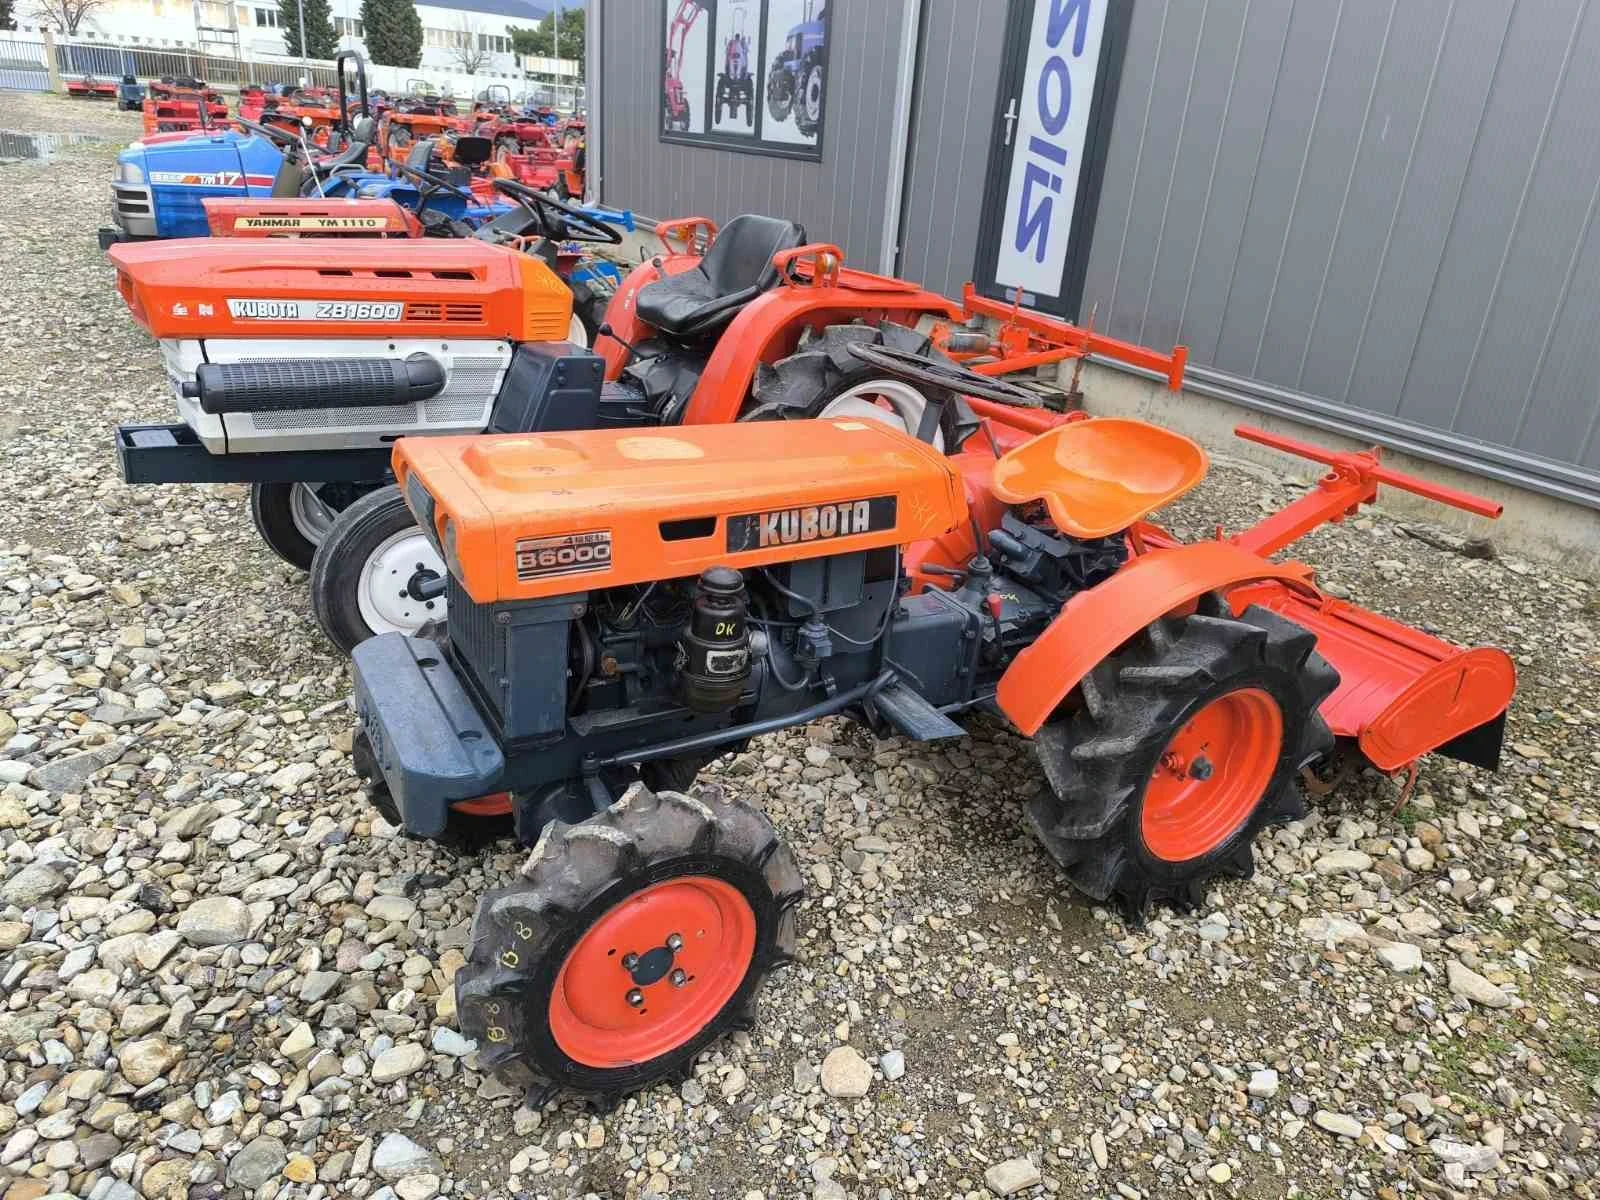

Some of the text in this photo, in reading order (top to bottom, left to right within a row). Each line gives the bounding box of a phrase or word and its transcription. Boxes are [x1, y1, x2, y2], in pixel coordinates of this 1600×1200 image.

[246, 219, 377, 228] YANMAR YM 1110
[233, 301, 299, 319] KUBOTA
[315, 303, 401, 320] ZB1600
[758, 500, 870, 547] KUBOTA
[517, 544, 611, 569] B6000
